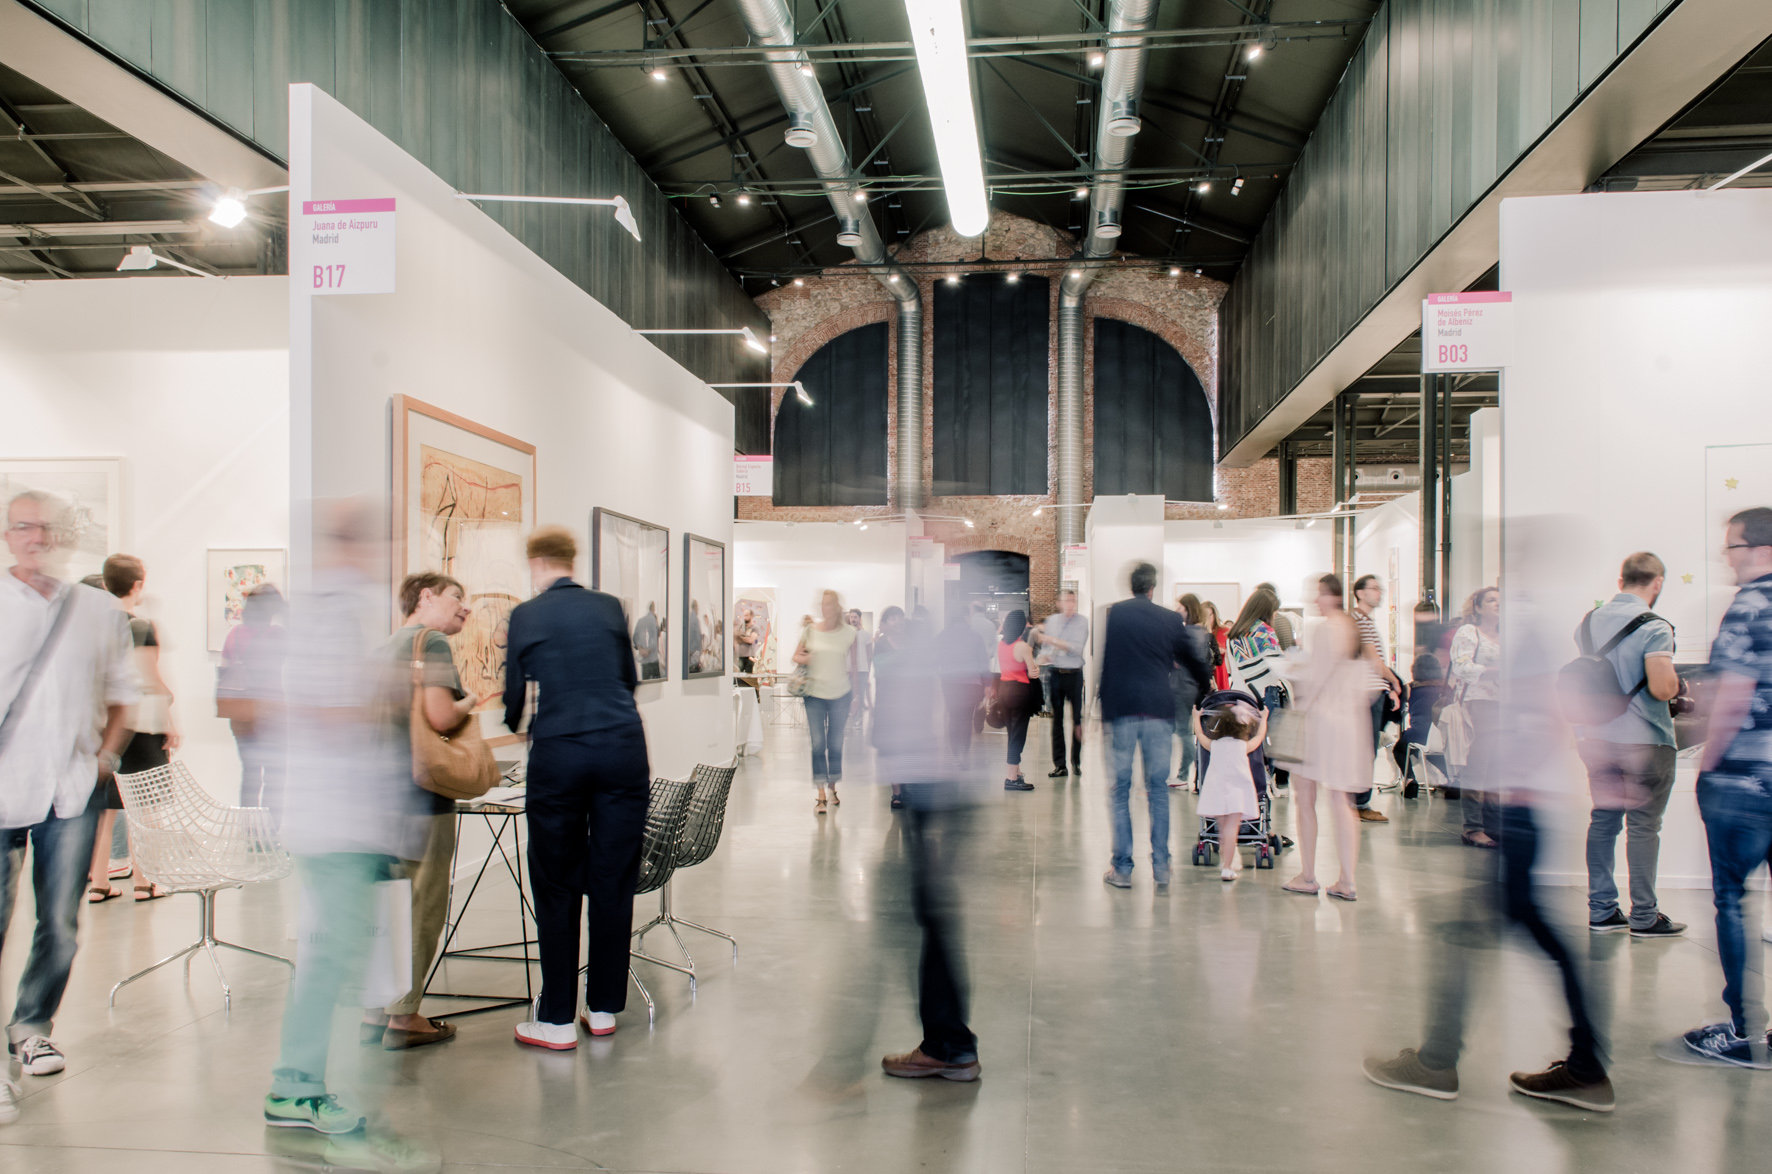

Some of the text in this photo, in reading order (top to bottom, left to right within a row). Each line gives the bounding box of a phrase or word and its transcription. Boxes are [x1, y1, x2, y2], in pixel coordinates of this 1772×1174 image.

[312, 202, 336, 212] GALERÍA
[312, 219, 378, 231] Juana de Aizpuru
[312, 234, 339, 244] Madrid
[313, 264, 346, 288] B17
[1438, 308, 1483, 317] Moisés Pérez
[1438, 318, 1473, 326] de Albéniz
[1438, 328, 1462, 336] Madrid
[1438, 344, 1468, 363] B03
[736, 483, 751, 493] B15
